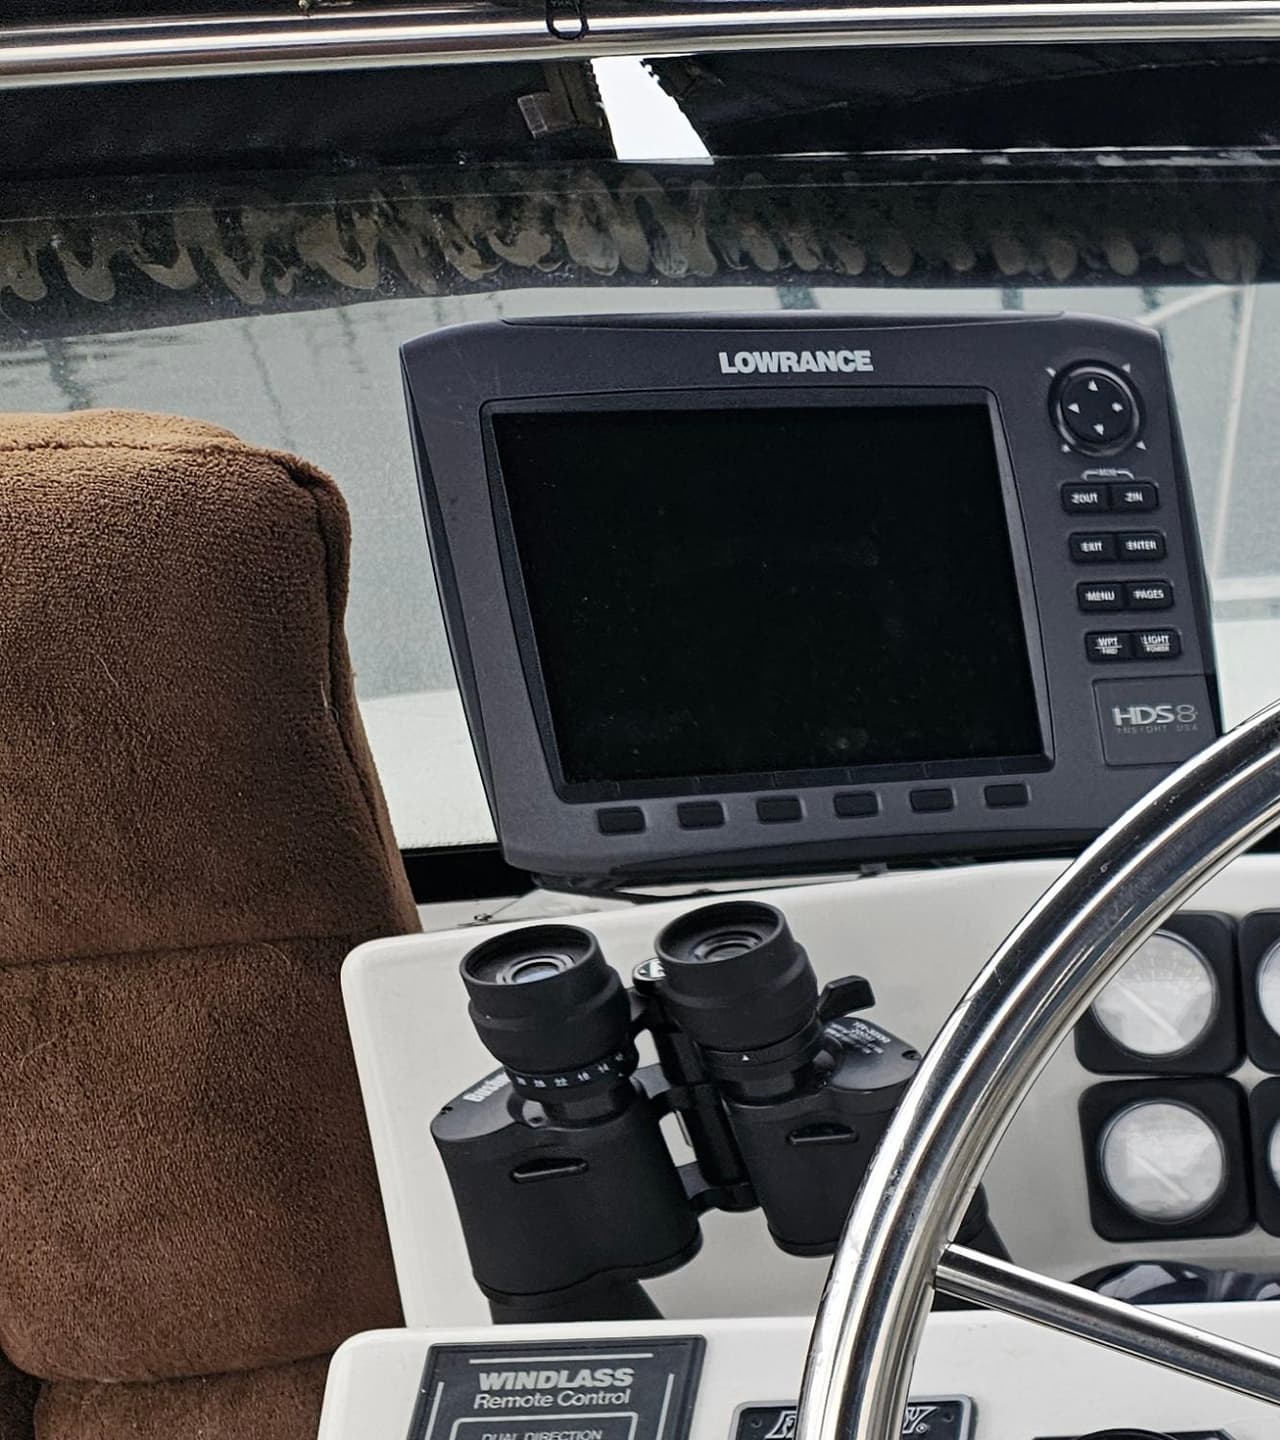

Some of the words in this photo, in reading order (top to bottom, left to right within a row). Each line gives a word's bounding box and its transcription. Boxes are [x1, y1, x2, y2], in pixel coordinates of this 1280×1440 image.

[719, 350, 873, 375] LOWRANCE
[1124, 491, 1144, 503] ZIN
[1080, 540, 1103, 552] EXIT
[1125, 539, 1157, 551] ENTER
[1085, 590, 1115, 602] MENU
[1133, 588, 1165, 600] PAGES
[1096, 635, 1119, 647] WPT
[1141, 634, 1170, 646] LIGHT
[478, 1366, 636, 1392] WINDLASS
[473, 1391, 554, 1410] Remote
[557, 1388, 632, 1408] Control
